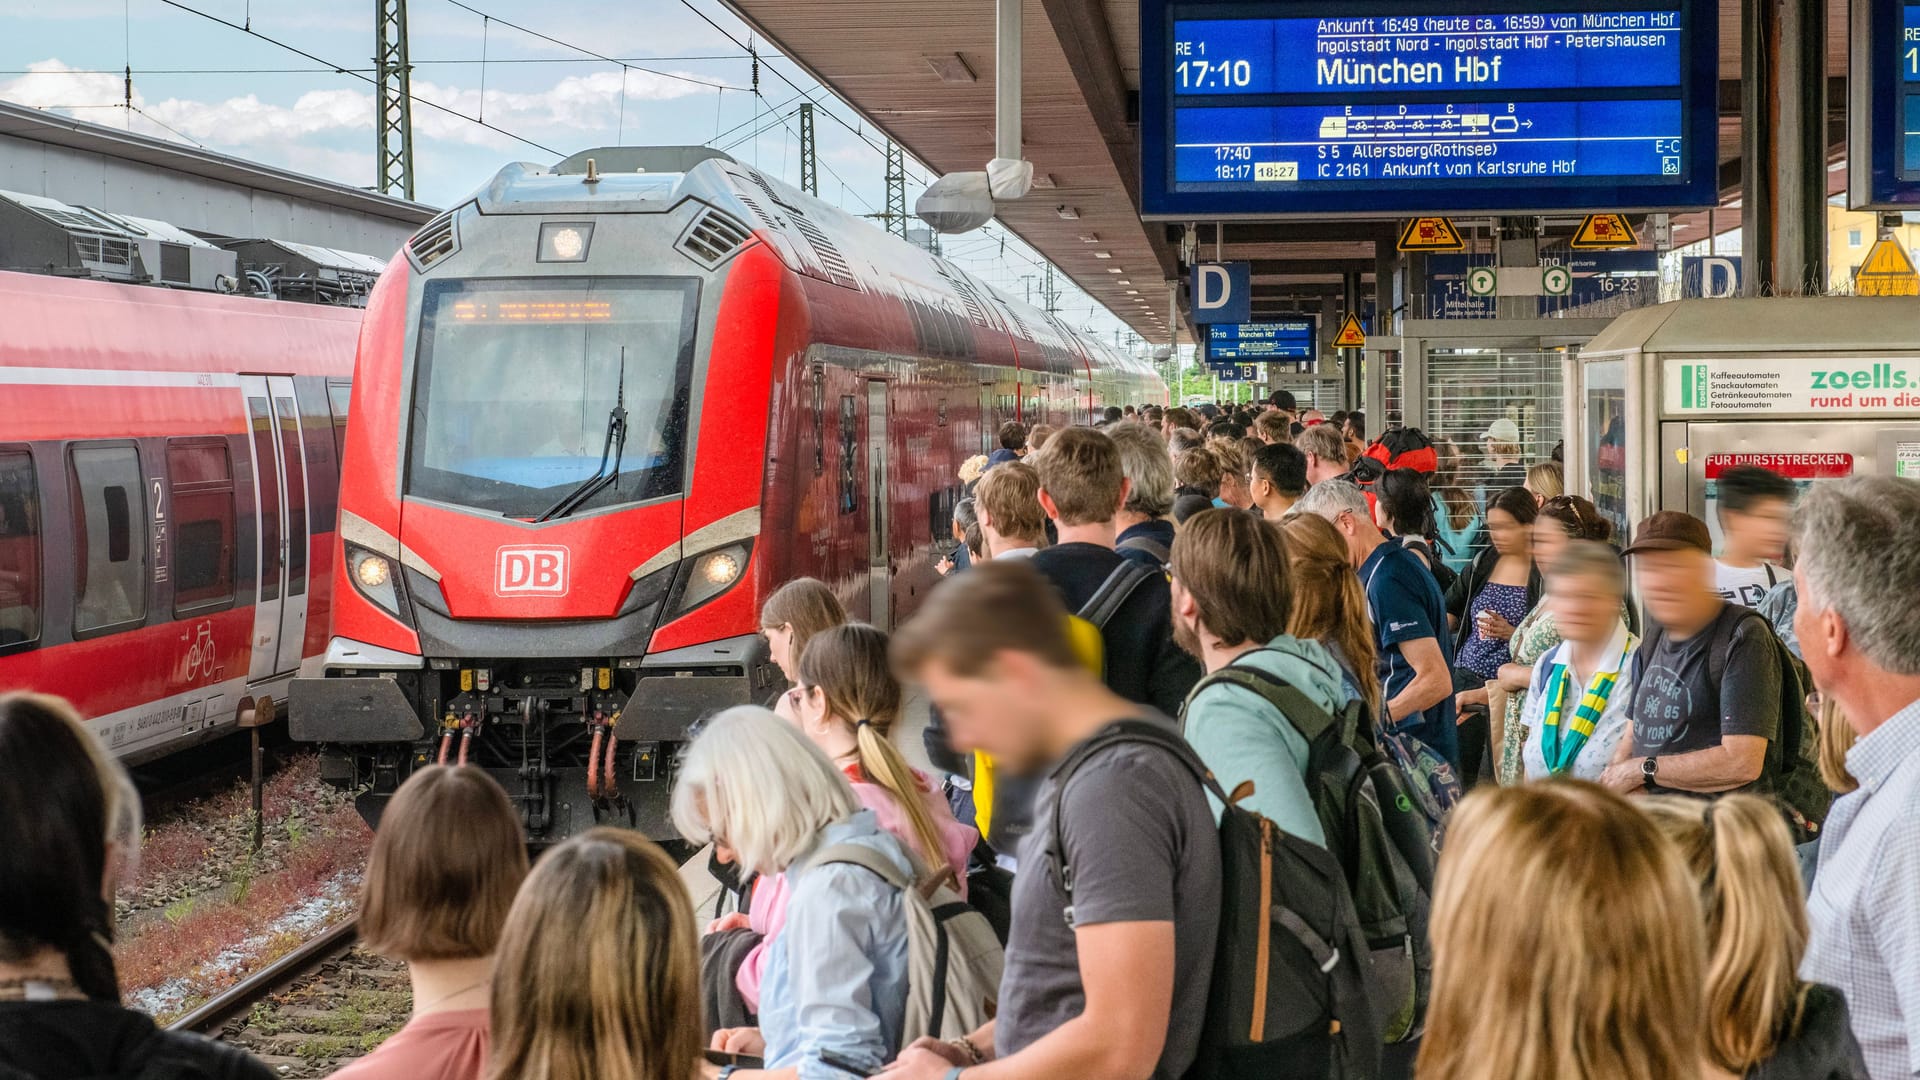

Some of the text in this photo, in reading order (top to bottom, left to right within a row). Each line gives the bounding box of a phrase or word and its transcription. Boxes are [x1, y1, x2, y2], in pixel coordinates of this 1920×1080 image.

[1317, 12, 1675, 34] Ankunft 16:49 (heute ca. 16:59) von München Hbf
[1175, 41, 1205, 55] RE 1
[1317, 38, 1391, 54] Ingolstadt
[1396, 37, 1429, 52] Nord
[1445, 35, 1519, 52] Ingolstadt
[1525, 34, 1549, 49] Hbf
[1565, 34, 1665, 48] Petershausen
[1175, 59, 1250, 88] 17:10
[1317, 55, 1502, 86] München Hbf
[1345, 103, 1515, 116] E D C B
[1214, 140, 1680, 161] 17:40 S 5 Allersberg(Rothsee) E-C
[1214, 165, 1251, 179] 18:17
[1257, 167, 1295, 178] 18:27
[1317, 160, 1577, 177] IC 2161 Ankunft von Karlsruhe Hbf
[1598, 278, 1639, 291] 16-23
[1702, 257, 1737, 299] D
[1198, 265, 1231, 309] D
[1222, 369, 1234, 378] 14
[1243, 366, 1252, 378] B
[1710, 371, 1780, 379] Kaffeeautomaten
[1810, 363, 1920, 389] zoells.
[1710, 381, 1778, 389] Snackautomaten
[1710, 391, 1792, 399] Getränkeautomaten
[1810, 391, 1920, 408] rund um die
[1710, 401, 1772, 409] Fotoautomaten
[1735, 454, 1848, 465] DURSTSTRECKEN.
[153, 482, 164, 519] 2
[504, 553, 559, 588] DB
[1663, 704, 1680, 720] 85
[1647, 724, 1673, 740] YORK
